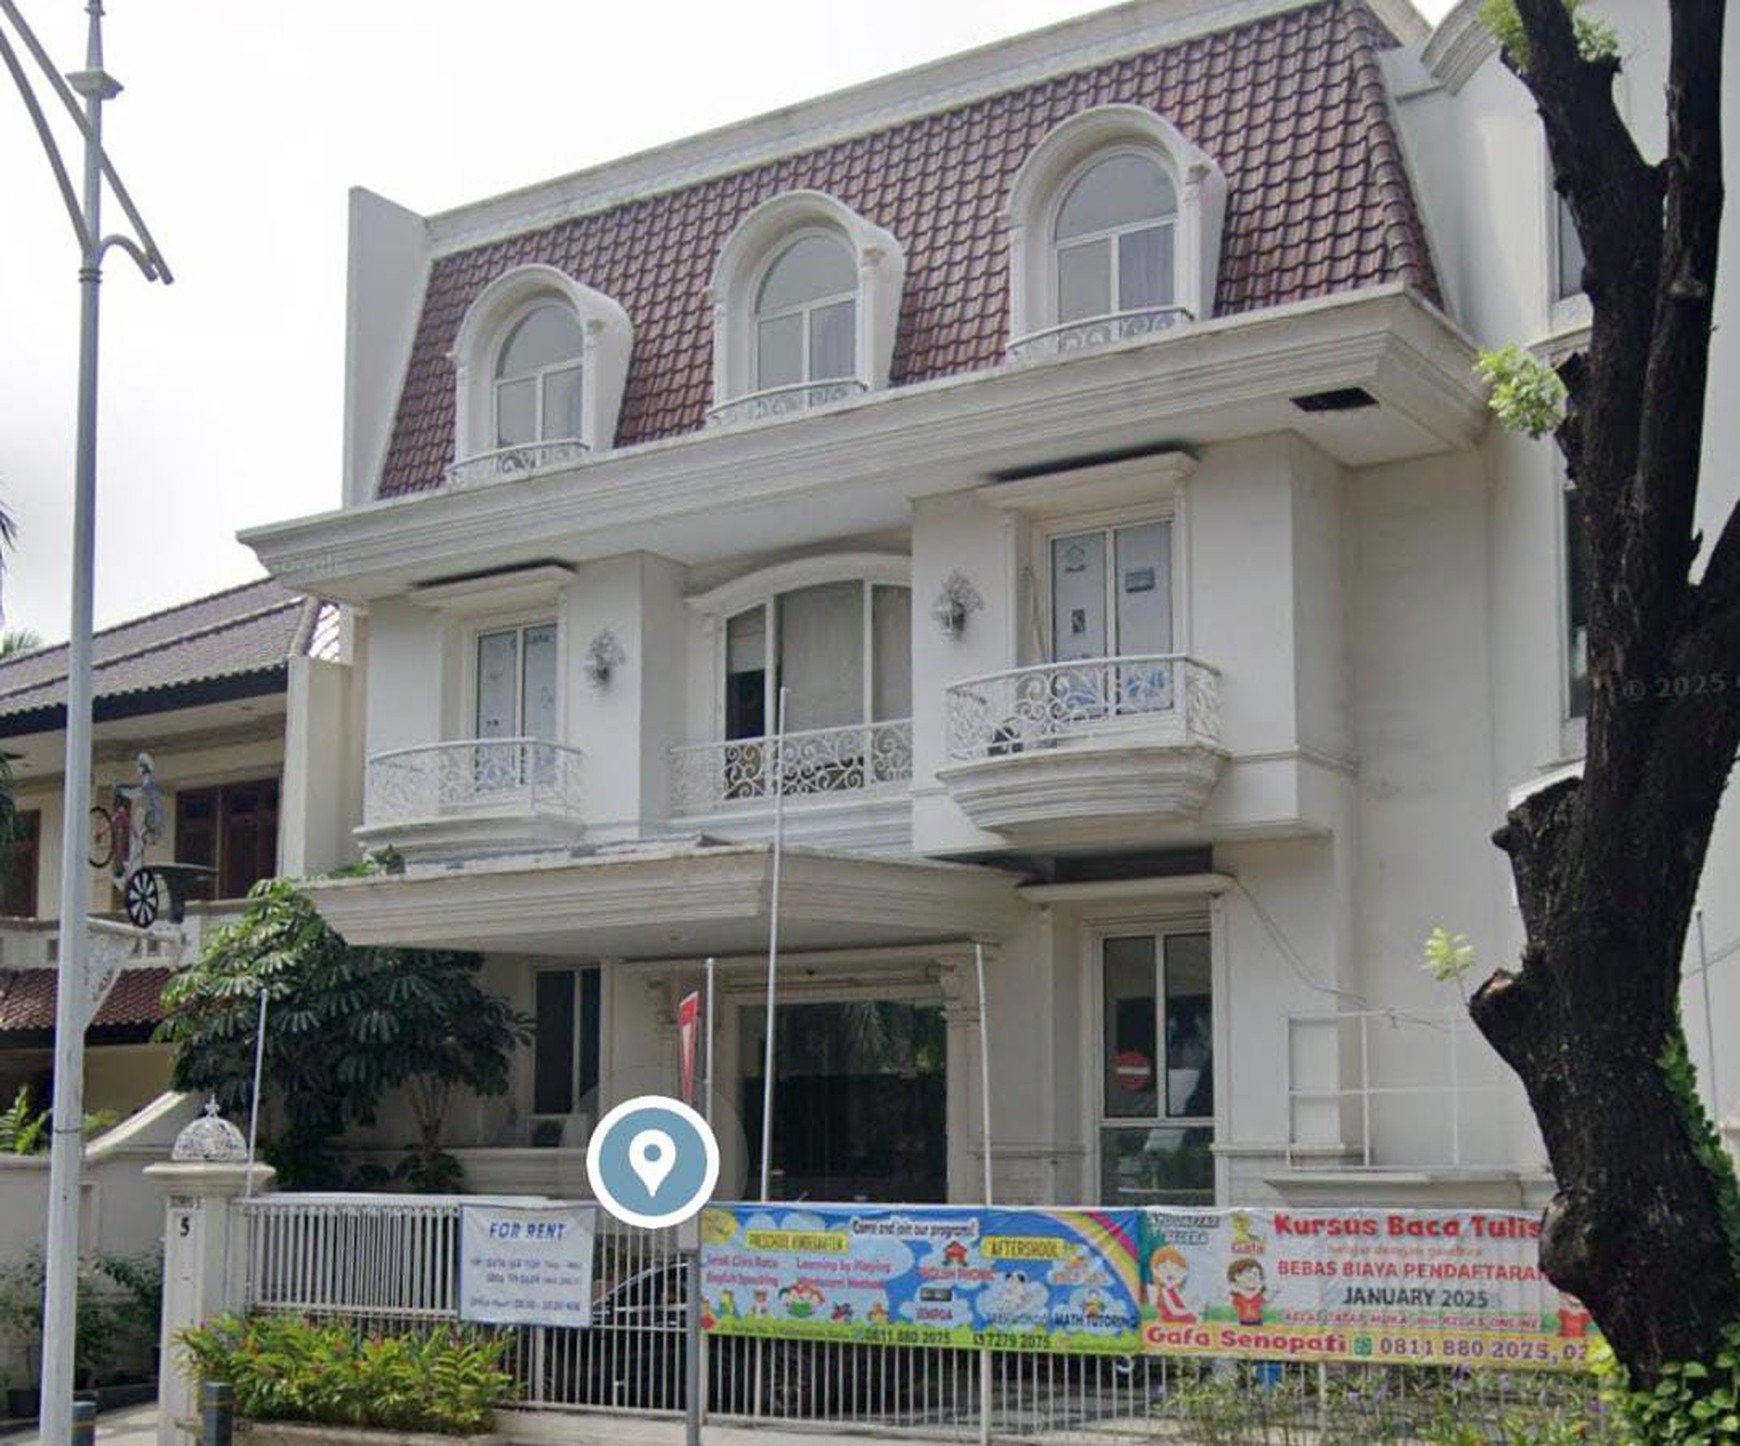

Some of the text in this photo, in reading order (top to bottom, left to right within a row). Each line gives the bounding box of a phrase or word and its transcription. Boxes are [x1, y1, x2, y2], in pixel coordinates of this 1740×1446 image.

[180, 1216, 190, 1237] 5
[489, 1221, 567, 1241] FOR RENT
[1274, 1214, 1542, 1239] Kursus Baca Tulis
[1278, 1260, 1338, 1276] BEBAS
[1342, 1261, 1399, 1278] BIAYA
[1342, 1286, 1489, 1309] JANUARY 2025
[1055, 1313, 1084, 1327] MATH
[1147, 1327, 1210, 1346] Gafa
[1221, 1331, 1346, 1353] Senopati
[1380, 1337, 1433, 1356] 0811
[1443, 1339, 1484, 1357] 880
